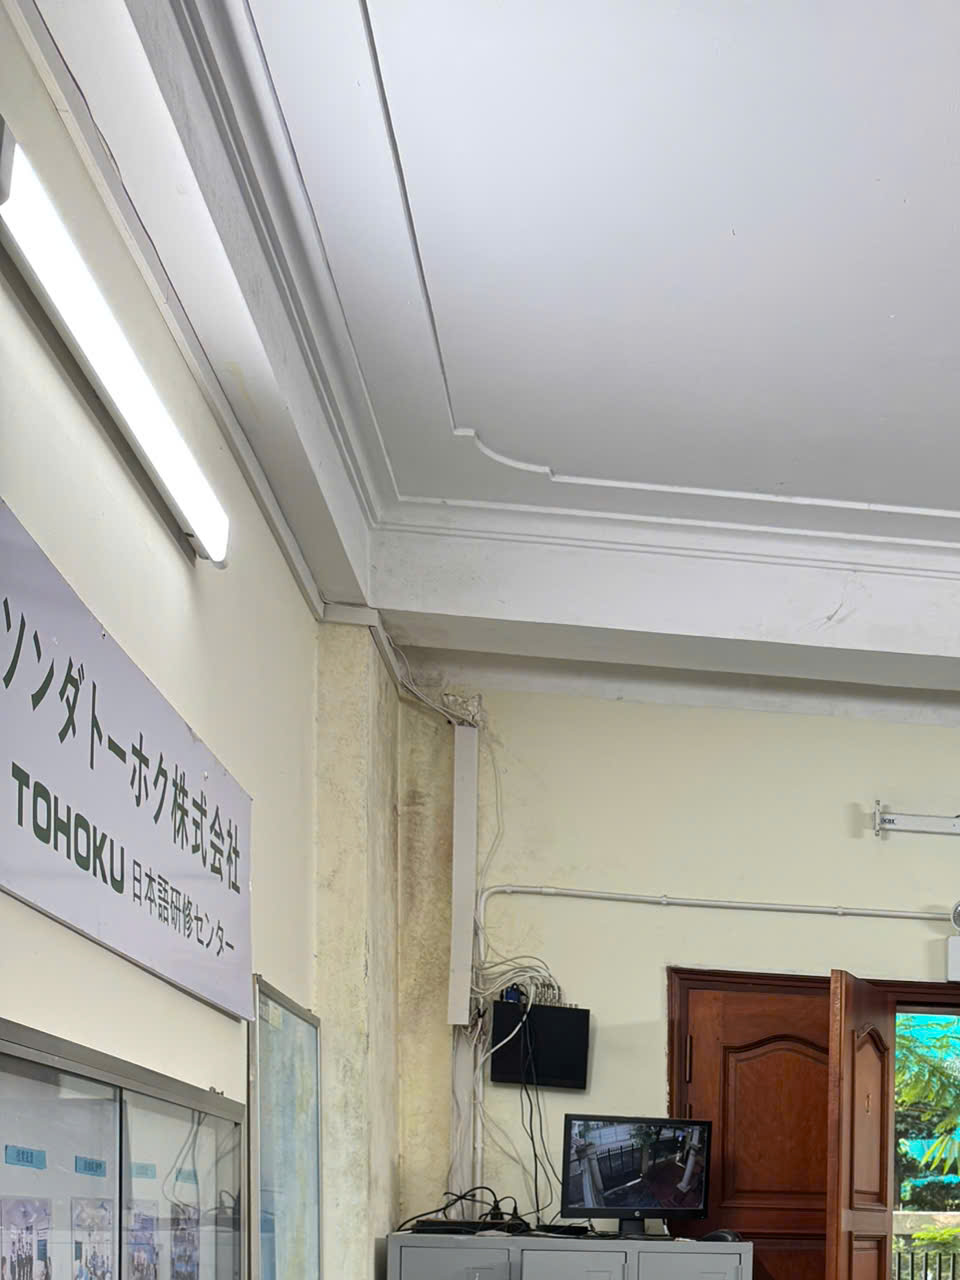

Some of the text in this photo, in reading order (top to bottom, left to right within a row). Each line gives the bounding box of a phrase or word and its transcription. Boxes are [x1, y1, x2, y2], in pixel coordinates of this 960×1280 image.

[2, 596, 241, 895] ソンダトーホク株式会社
[11, 761, 235, 957] TOHOKU 日本語研修センター
